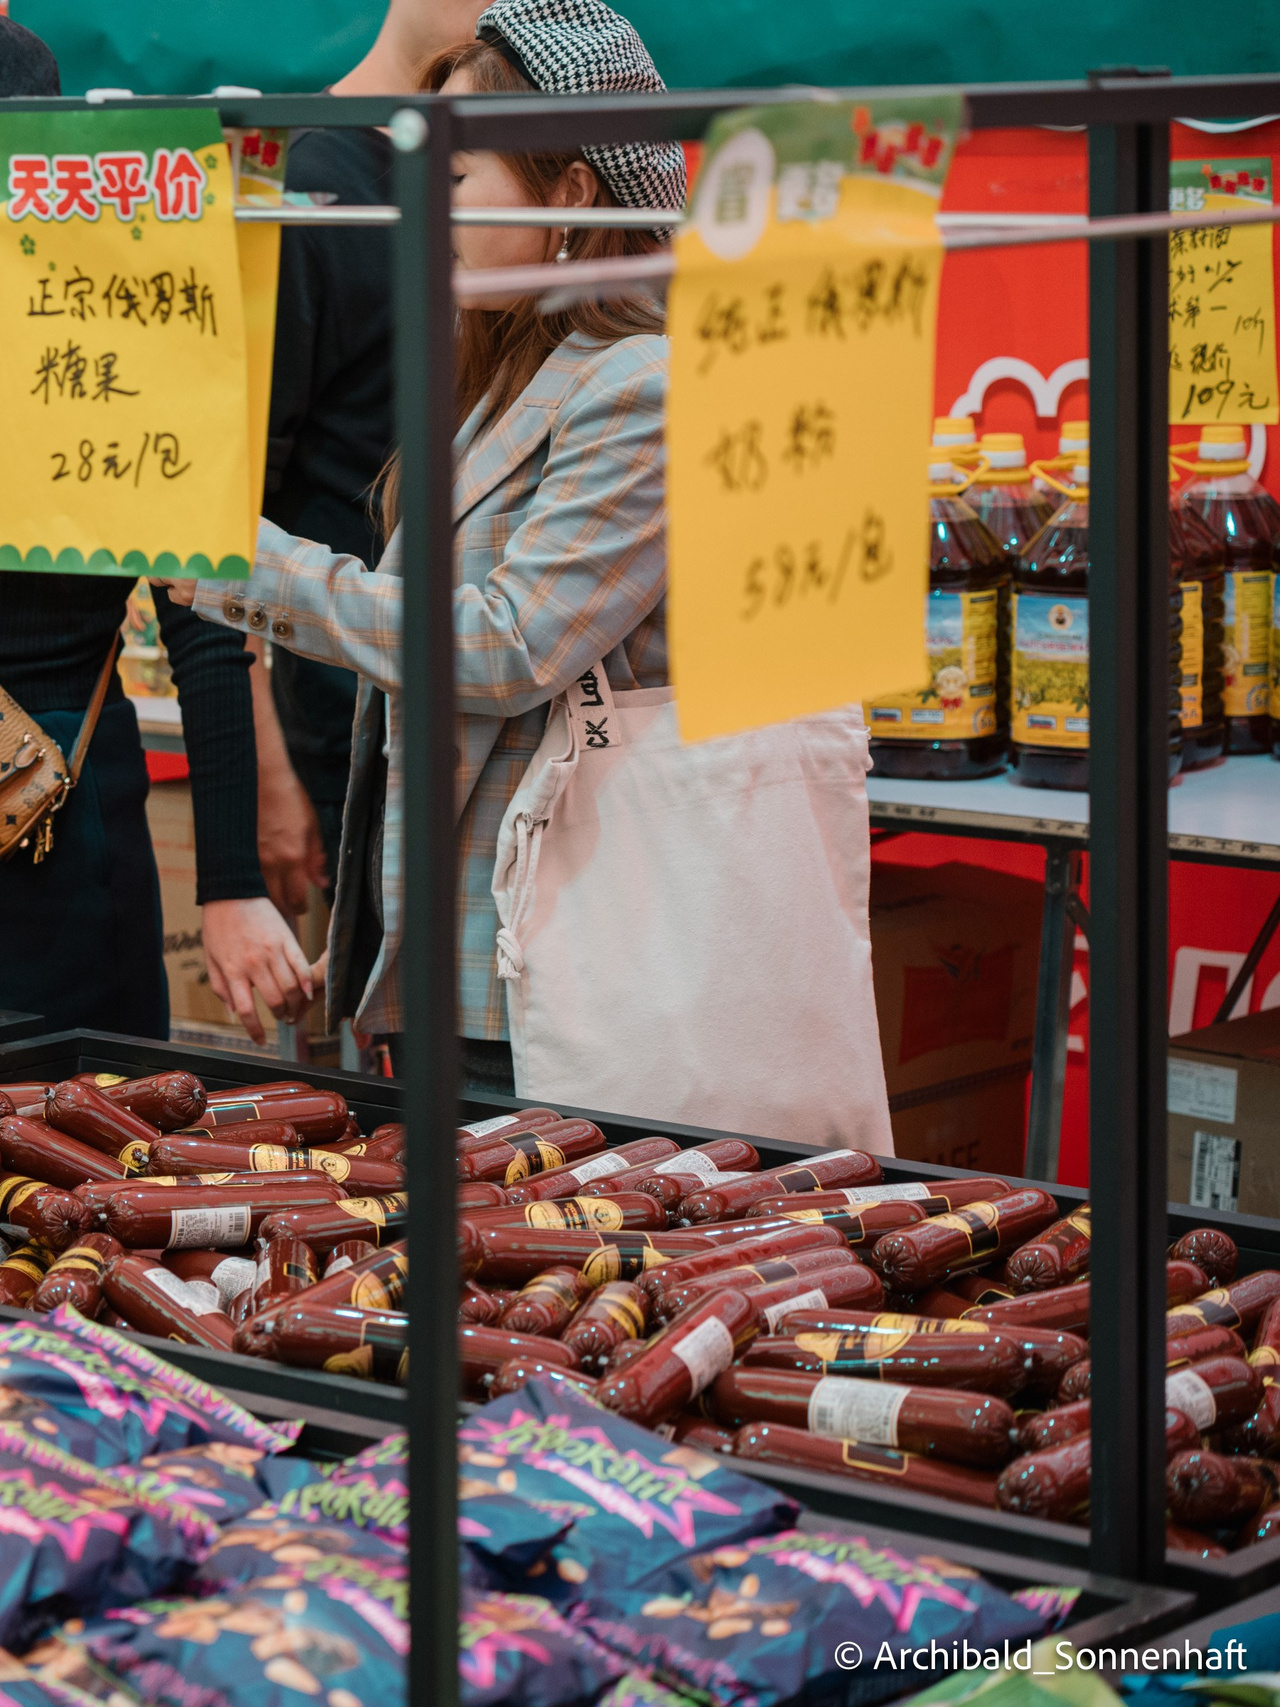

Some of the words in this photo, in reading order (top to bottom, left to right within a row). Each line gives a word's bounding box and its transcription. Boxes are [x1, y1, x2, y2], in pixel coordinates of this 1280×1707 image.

[9, 150, 206, 221] 天天平价
[27, 265, 218, 337] 正宗俄罗斯
[31, 339, 141, 405] 糖果
[1182, 380, 1270, 420] 109元
[51, 432, 192, 488] 28元/包
